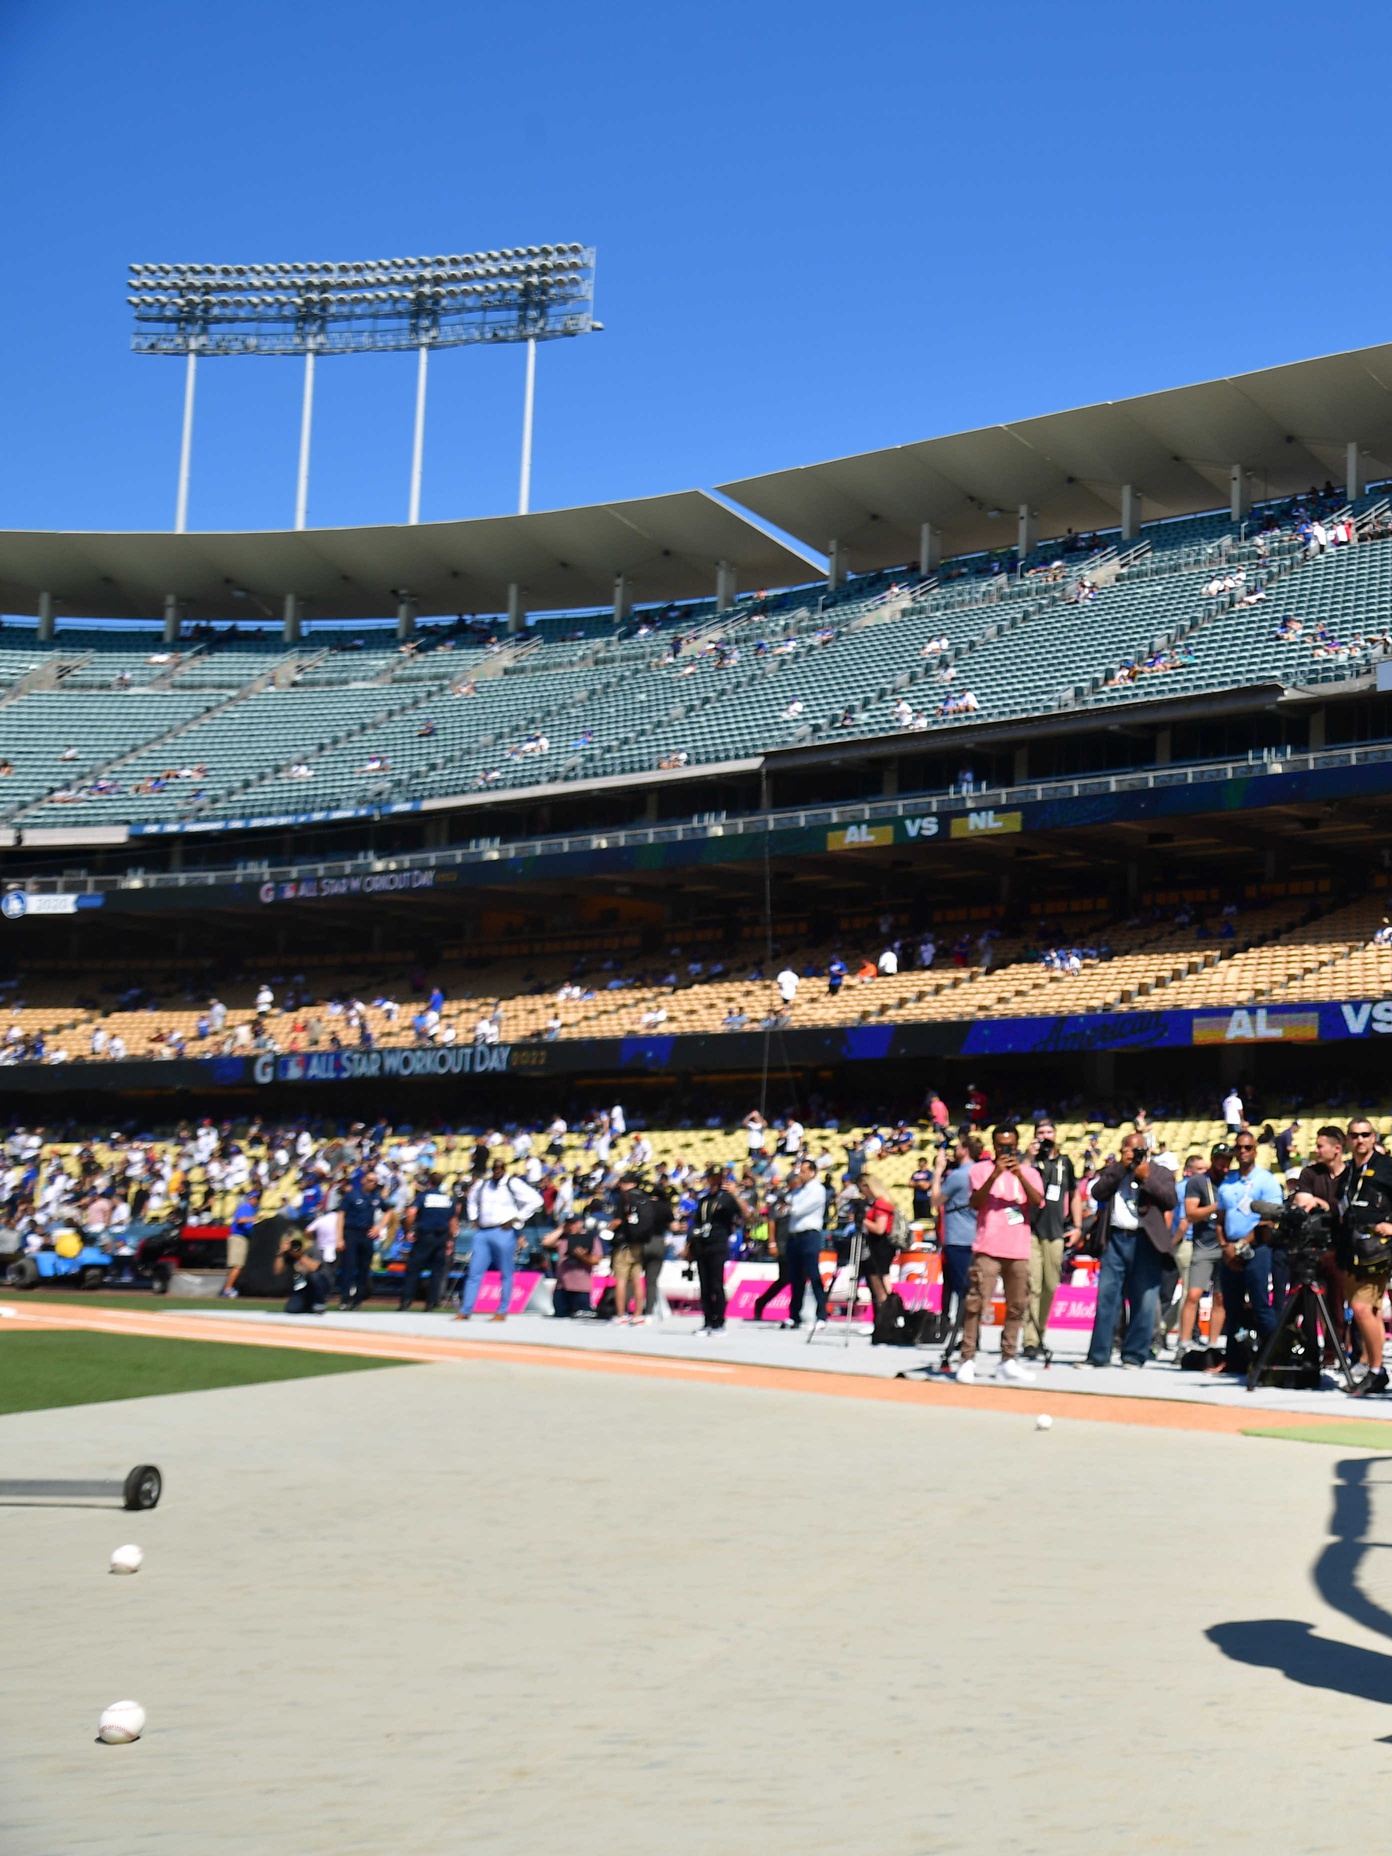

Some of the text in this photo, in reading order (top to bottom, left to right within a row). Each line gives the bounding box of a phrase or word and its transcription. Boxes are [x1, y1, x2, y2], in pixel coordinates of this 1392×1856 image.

[844, 810, 1004, 844] AL VS NL
[1225, 1008, 1284, 1040] AL
[306, 1053, 337, 1079] ALL
[340, 1052, 381, 1077] STAR
[382, 1047, 474, 1076] WORKOUT
[474, 1045, 512, 1072] DAY
